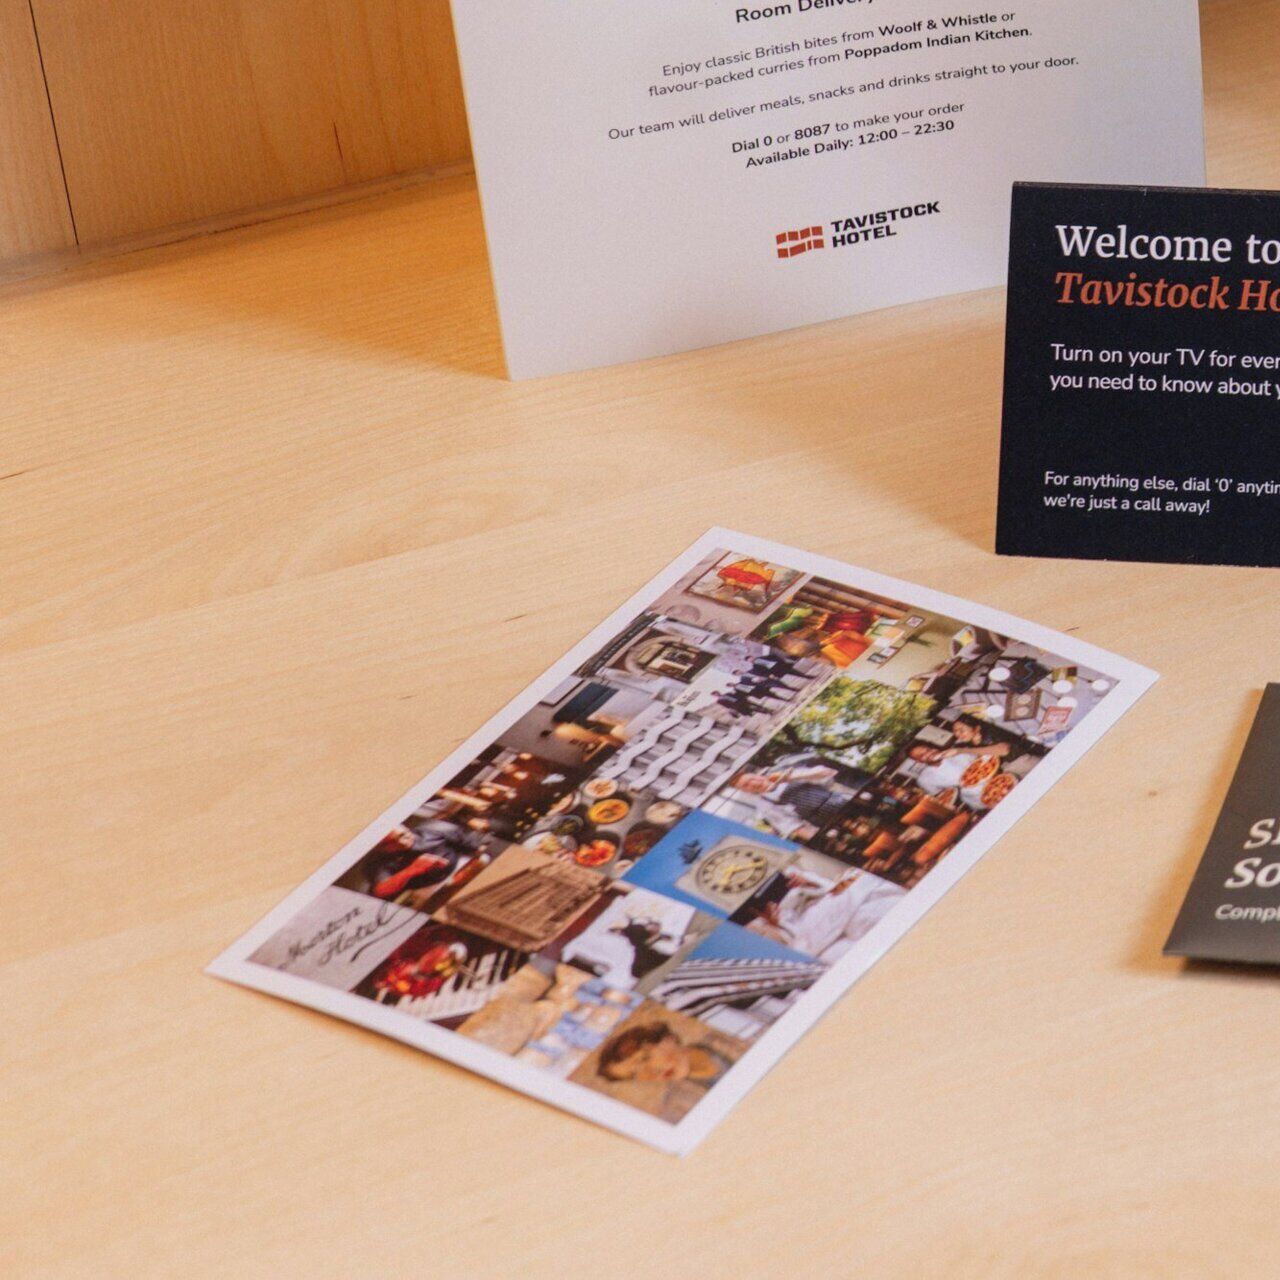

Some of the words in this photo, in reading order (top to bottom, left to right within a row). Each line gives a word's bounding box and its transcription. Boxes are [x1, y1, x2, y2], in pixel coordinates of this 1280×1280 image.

[735, 4, 792, 24] Room
[662, 62, 702, 77] Enjoy
[705, 52, 751, 69] classic
[755, 41, 800, 59] British
[804, 36, 838, 50] bites
[841, 30, 875, 43] from
[878, 20, 923, 37] Woolf
[926, 19, 938, 31] &
[941, 12, 998, 28] Whistle
[1001, 13, 1015, 22] or
[648, 66, 755, 98] flavour-packed
[757, 60, 806, 82] curries
[807, 53, 841, 67] from
[844, 40, 923, 60] Poppadom
[926, 33, 971, 48] Indian
[974, 28, 1033, 42] Kitchen.
[608, 127, 635, 140] Our
[638, 121, 675, 135] team
[678, 113, 705, 128] will
[708, 105, 756, 122] deliver
[759, 95, 805, 112] meals,
[808, 85, 855, 102] snacks
[858, 78, 885, 93] and
[888, 73, 931, 88] drinks
[934, 65, 989, 81] straight
[991, 64, 1006, 74] to
[1009, 60, 1041, 74] your
[1044, 57, 1080, 68] door.
[731, 137, 760, 154] Dial
[763, 135, 773, 147] 0
[776, 134, 790, 144] or
[794, 123, 831, 141] 8087
[835, 122, 850, 132] to
[853, 114, 890, 129] make
[893, 109, 924, 124] your
[927, 103, 965, 116] order
[745, 146, 810, 169] Available
[813, 138, 854, 155] Daily:
[858, 128, 898, 146] 12:00
[913, 119, 955, 136] 22:30
[830, 200, 941, 233] TAVISTOCK
[831, 224, 898, 248] HOTEL
[1054, 224, 1233, 263] Welcome
[1055, 271, 1230, 310] Tavistock
[1050, 343, 1094, 362] Turn
[1098, 349, 1123, 363] on
[1128, 351, 1172, 368] your
[1175, 348, 1206, 366] TV
[1208, 349, 1237, 368] for
[1049, 374, 1084, 391] you
[1087, 373, 1134, 391] need
[1137, 375, 1158, 392] to
[1161, 374, 1214, 394] know
[1217, 377, 1272, 397] about
[1044, 470, 1070, 486] For
[1072, 473, 1140, 492] anything
[1142, 475, 1179, 492] else,
[1182, 476, 1211, 492] dial
[1043, 493, 1086, 509] we're
[1087, 494, 1118, 512] just
[1120, 499, 1131, 510] a
[1133, 496, 1162, 512] call
[1164, 499, 1211, 517] away!
